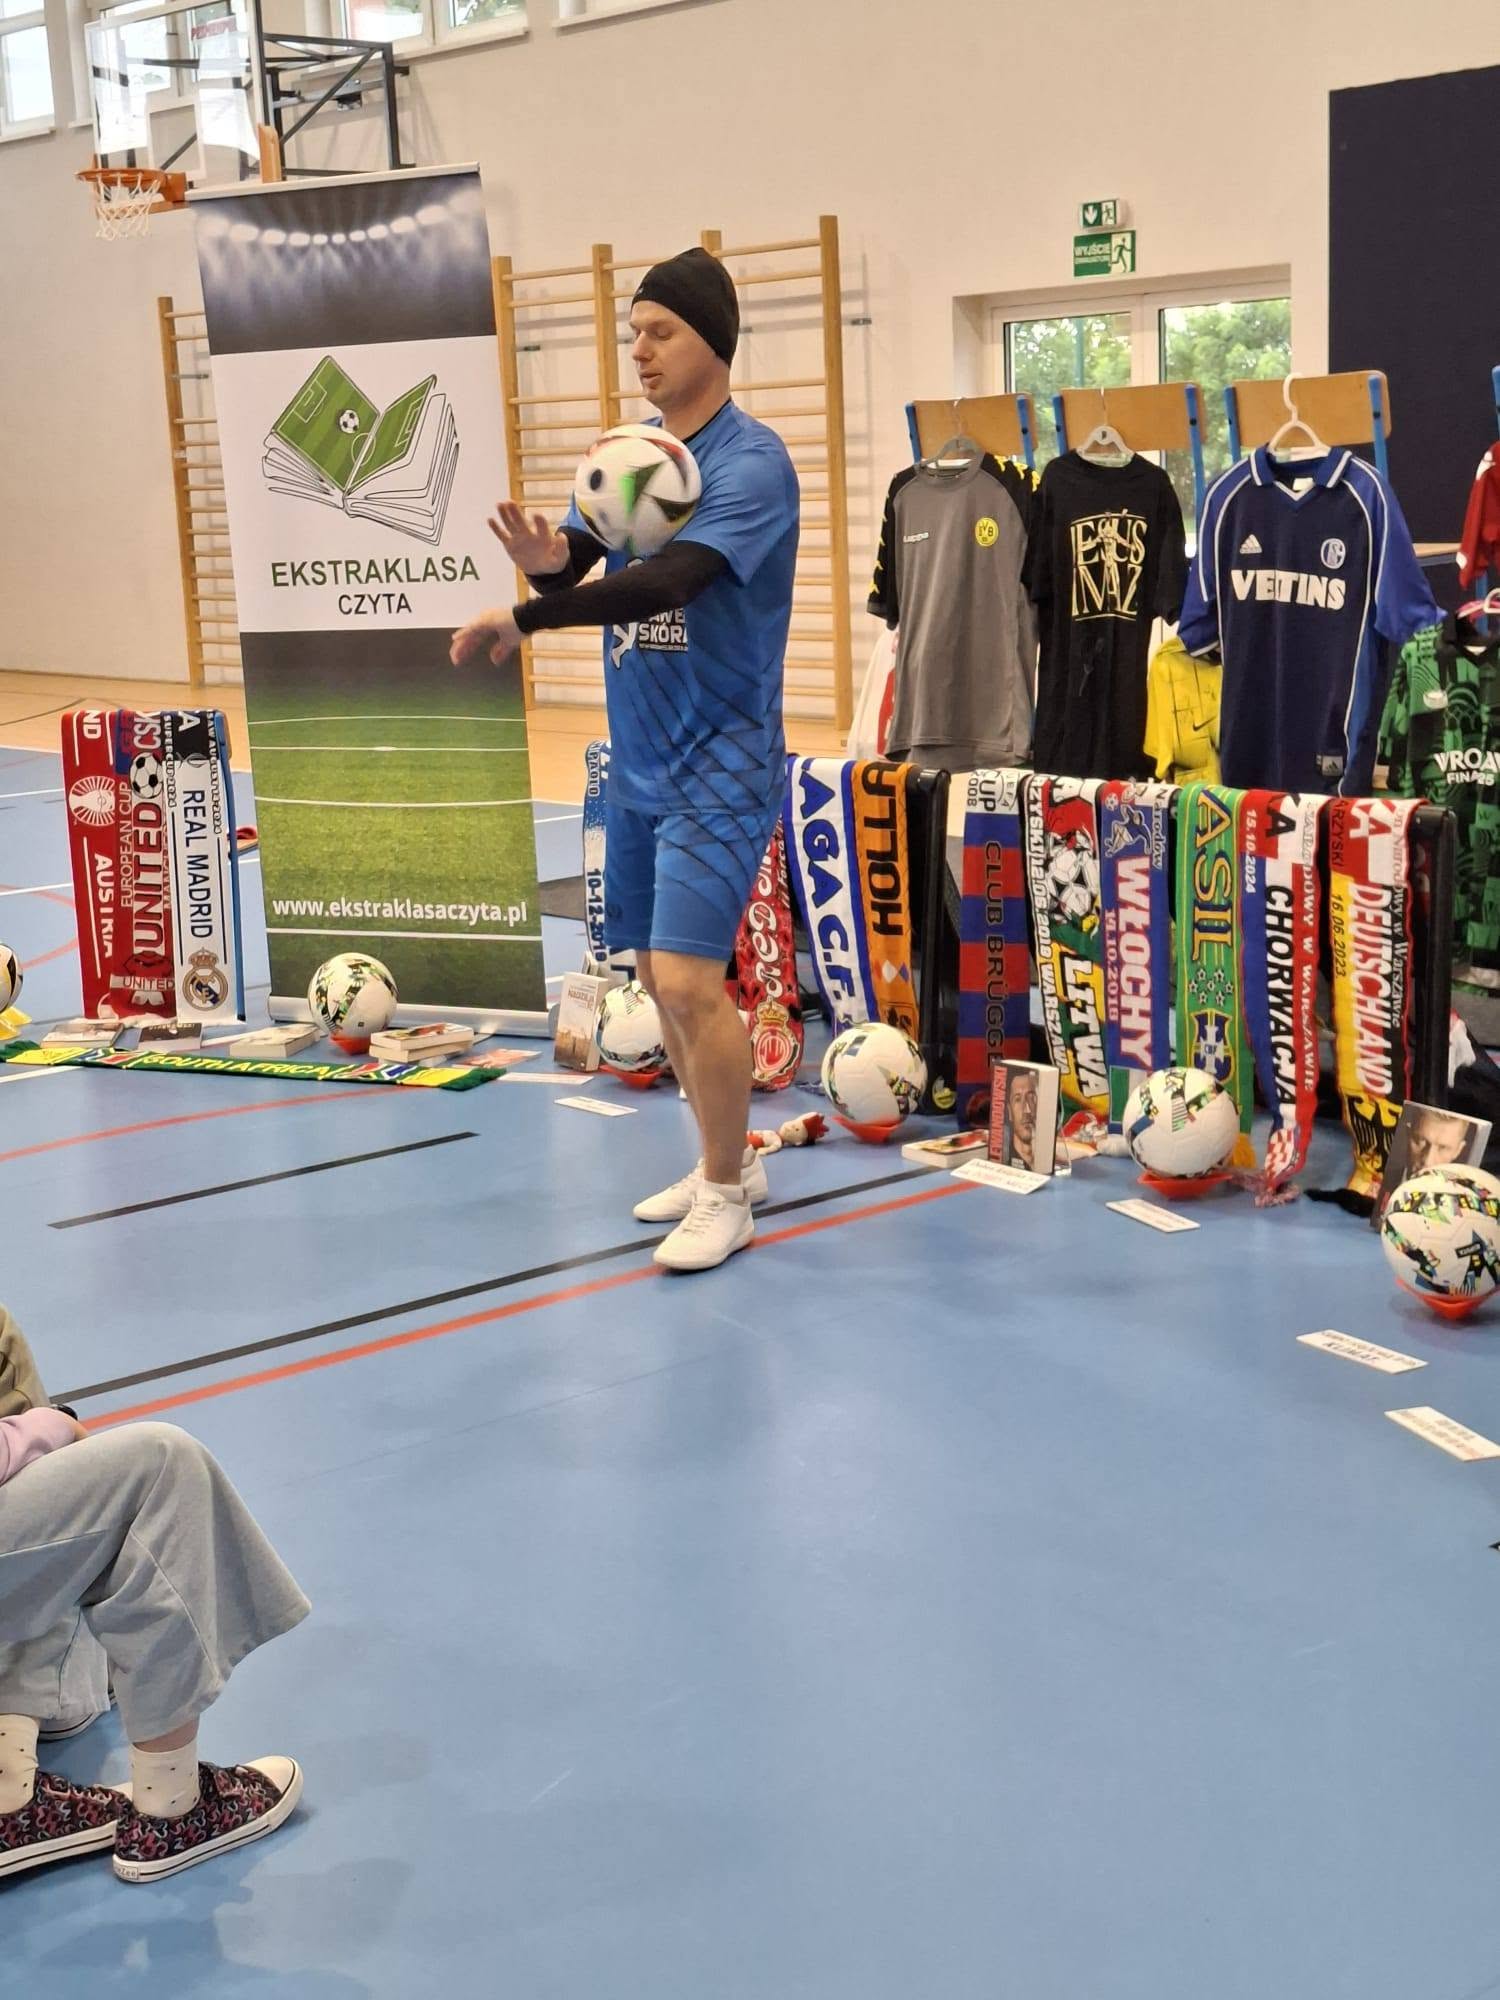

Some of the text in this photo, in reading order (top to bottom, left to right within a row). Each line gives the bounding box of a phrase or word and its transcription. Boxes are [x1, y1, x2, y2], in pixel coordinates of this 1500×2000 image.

[271, 555, 481, 587] EKSTRAKLASA
[338, 593, 412, 615] CZYTA
[164, 715, 175, 778] SUPERCUP
[119, 782, 134, 907] EUROPEAN CUP
[133, 802, 163, 949] UNITED
[183, 790, 214, 938] REAL MADRID
[799, 762, 843, 908] AGA
[985, 841, 1004, 926] CLUB
[1245, 808, 1258, 893] 15.10.2024
[272, 897, 528, 927] www.ekstraklasaczyta.pl
[1118, 857, 1153, 1072] WŁOCHY
[1303, 937, 1314, 954] W
[122, 977, 175, 991] UNITED
[1040, 963, 1071, 1075] WARSZAWA
[1065, 956, 1110, 1098] LITWA
[1265, 885, 1297, 1104] CHORWACJA
[1302, 964, 1315, 1092] WARSZAWIE
[1349, 881, 1393, 1095] DEUTSCHLAND
[143, 1053, 328, 1076] SOUTH AFRICA
